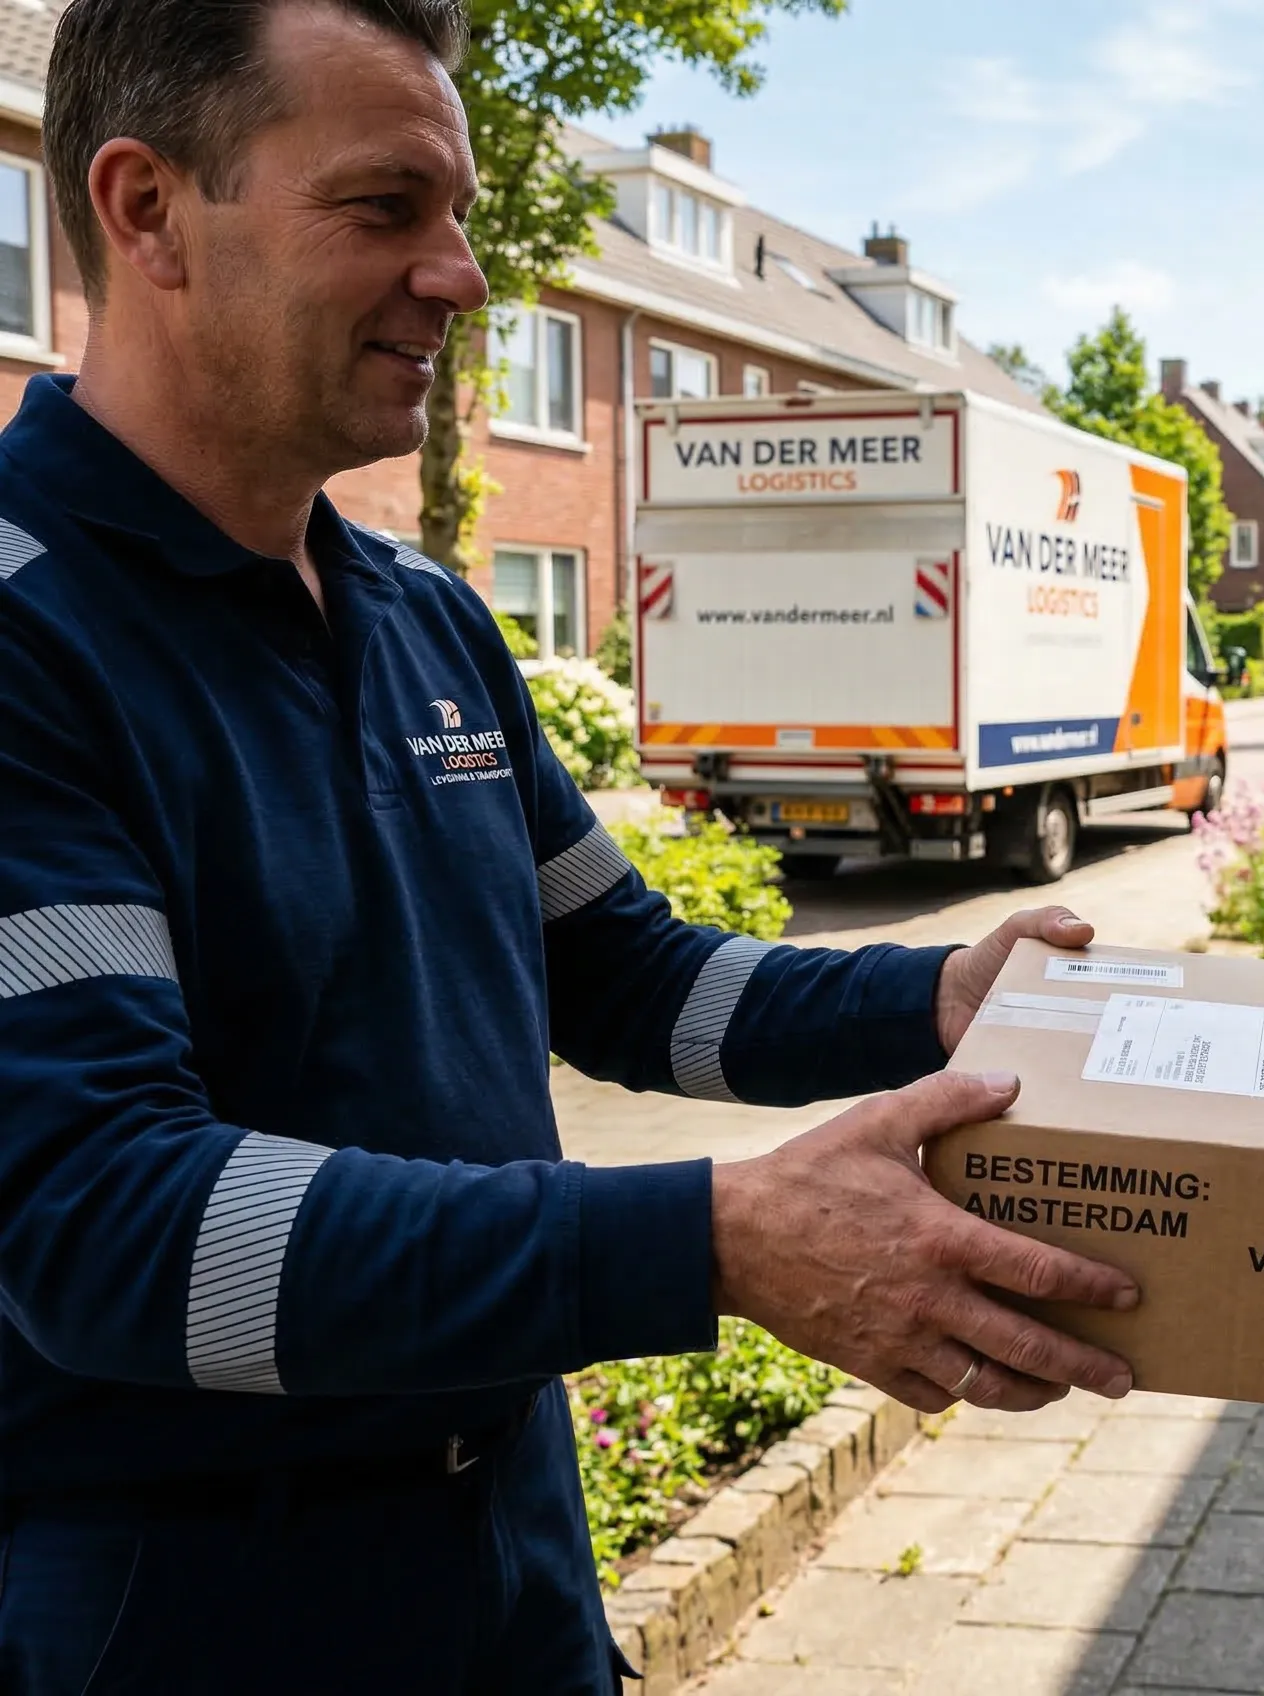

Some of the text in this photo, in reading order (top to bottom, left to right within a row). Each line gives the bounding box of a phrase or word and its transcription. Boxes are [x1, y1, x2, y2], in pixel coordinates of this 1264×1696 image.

[676, 436, 921, 467] VAN DER MEER
[738, 470, 858, 492] LOGISTICS
[986, 522, 1130, 582] VAN DER MEER
[697, 604, 894, 624] www.vandermeer.nl
[406, 735, 445, 755] VAN
[442, 734, 473, 753] DER
[965, 1152, 1210, 1201] BESTEMMING:
[963, 1191, 1188, 1238] AMSTERDAM
